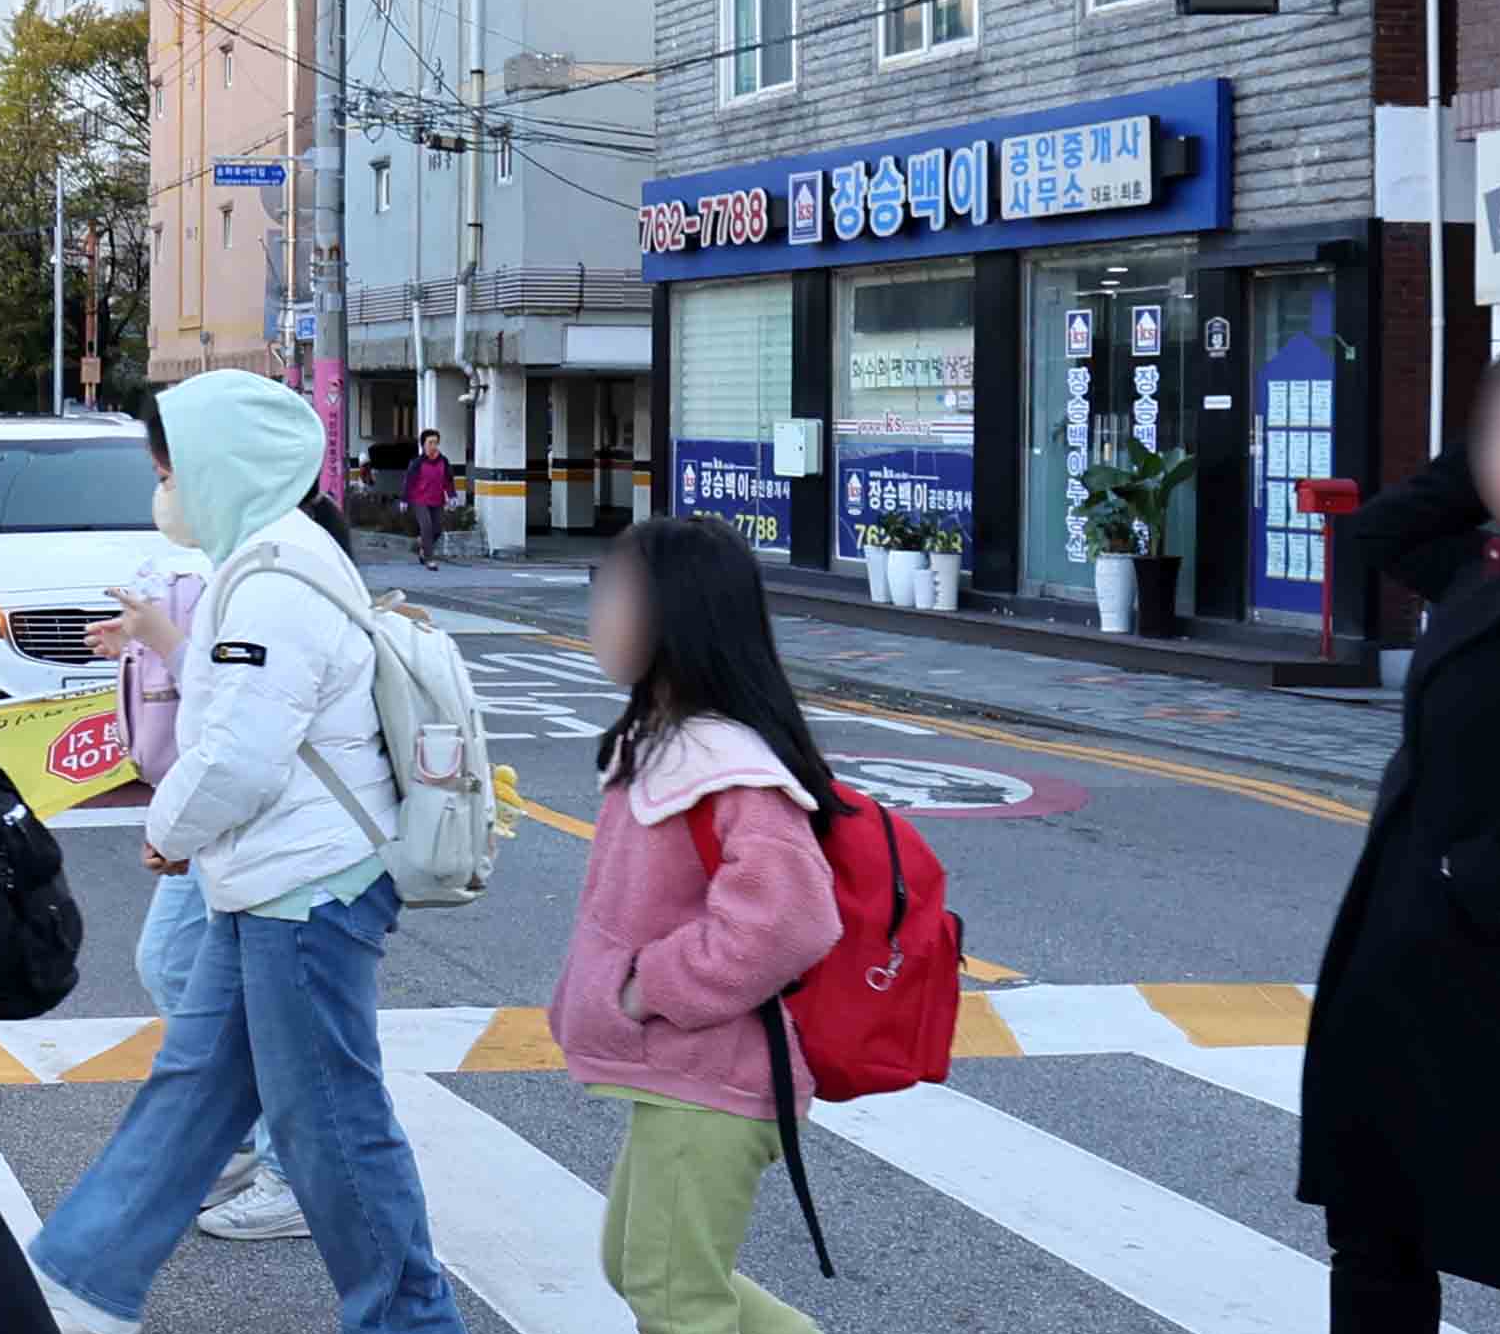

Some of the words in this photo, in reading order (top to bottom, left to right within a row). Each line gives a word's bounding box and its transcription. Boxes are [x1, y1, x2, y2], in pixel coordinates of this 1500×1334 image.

[1009, 121, 1142, 176] 공인중개사
[830, 139, 988, 241] 장승백이
[1009, 172, 1084, 214] 사무소
[638, 187, 767, 253] 762-7788
[701, 470, 750, 501] 장승백이
[868, 480, 927, 512] 장승백이
